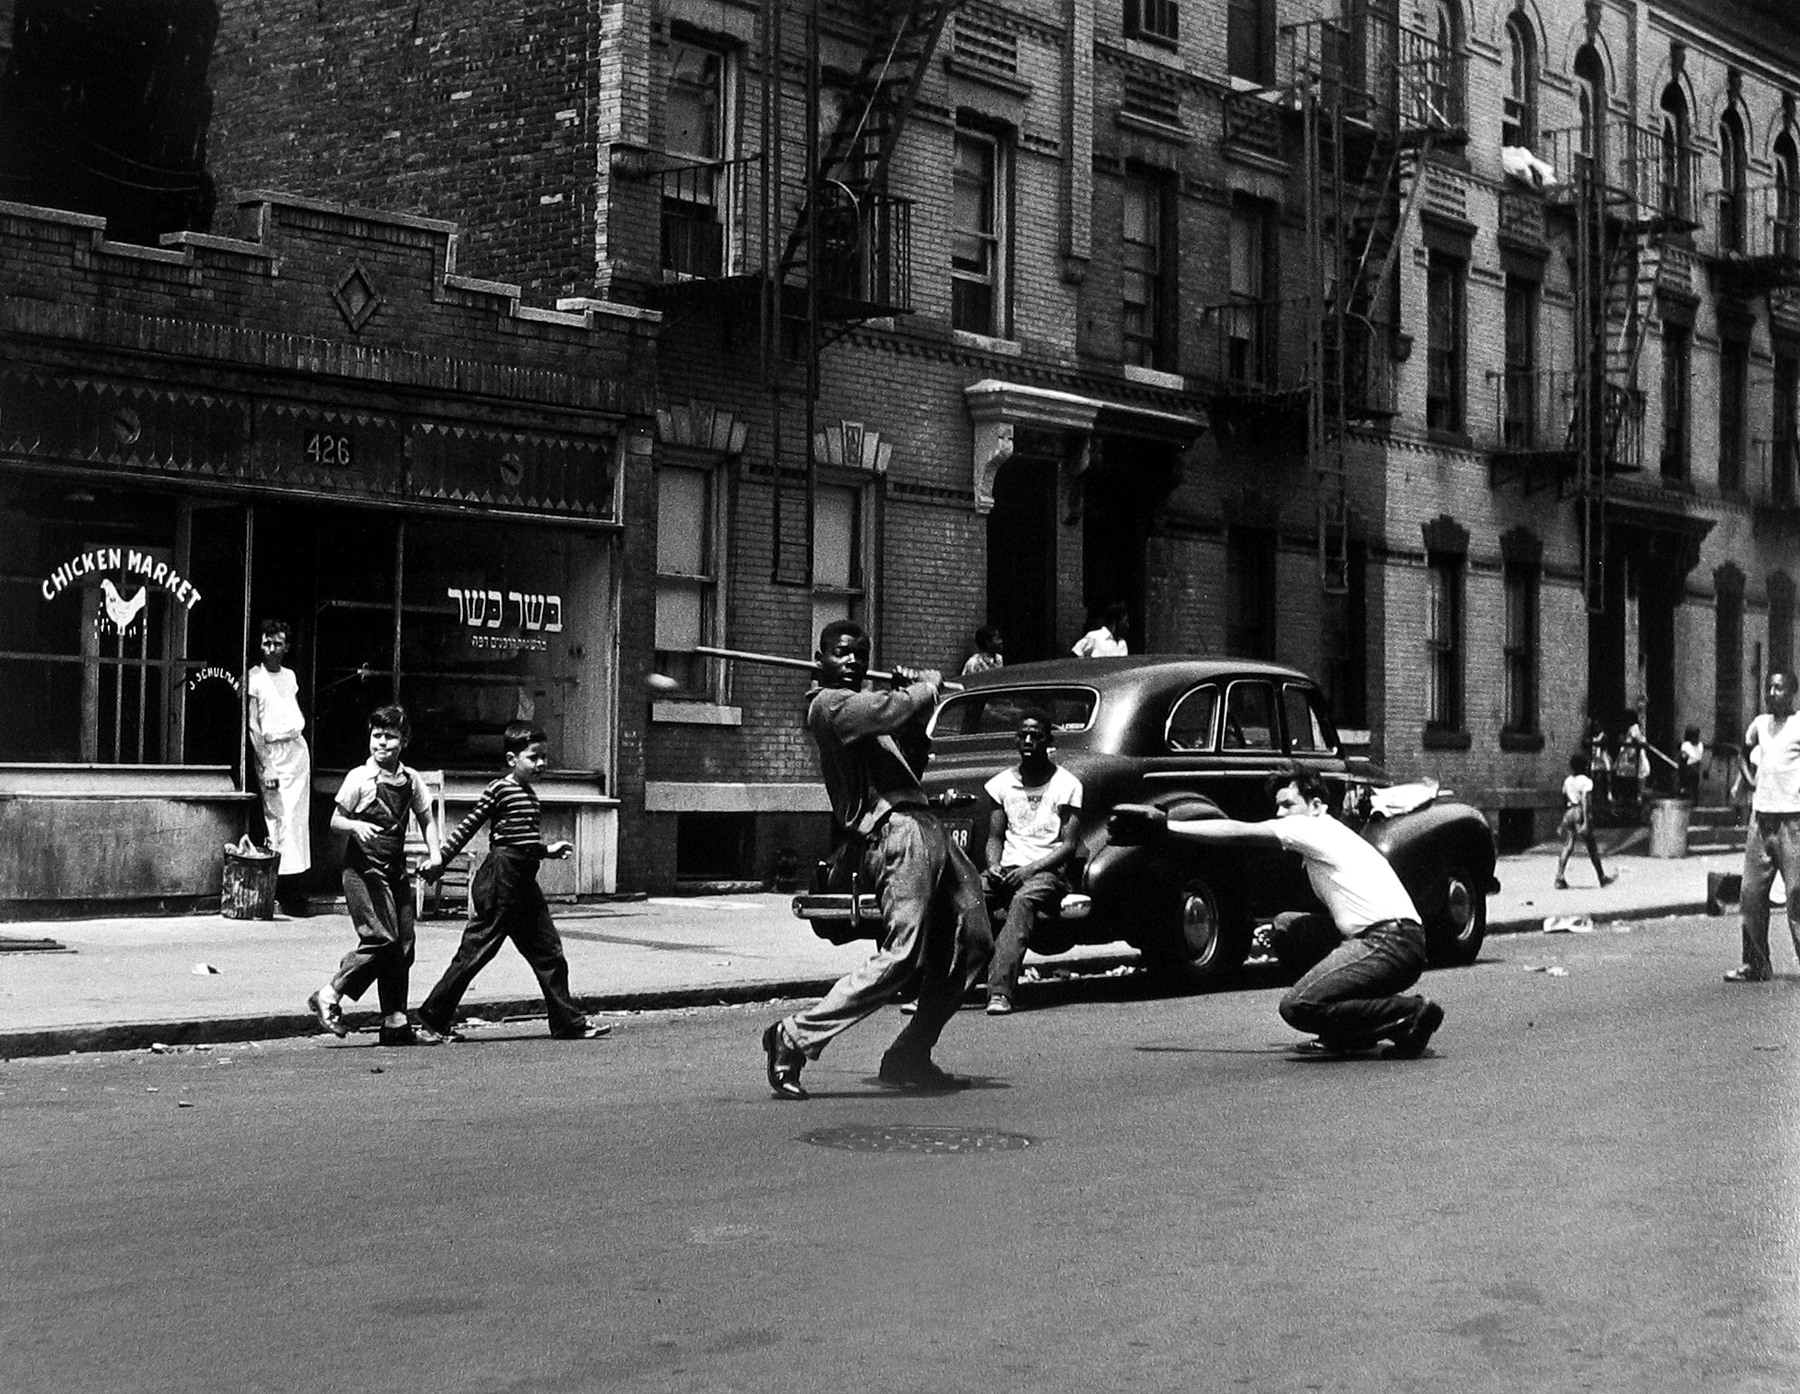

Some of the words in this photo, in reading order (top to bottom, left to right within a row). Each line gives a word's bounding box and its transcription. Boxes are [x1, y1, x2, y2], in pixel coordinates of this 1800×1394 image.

[306, 433, 351, 466] 426
[42, 548, 122, 600] CHICKEN
[128, 549, 202, 609] MARKET
